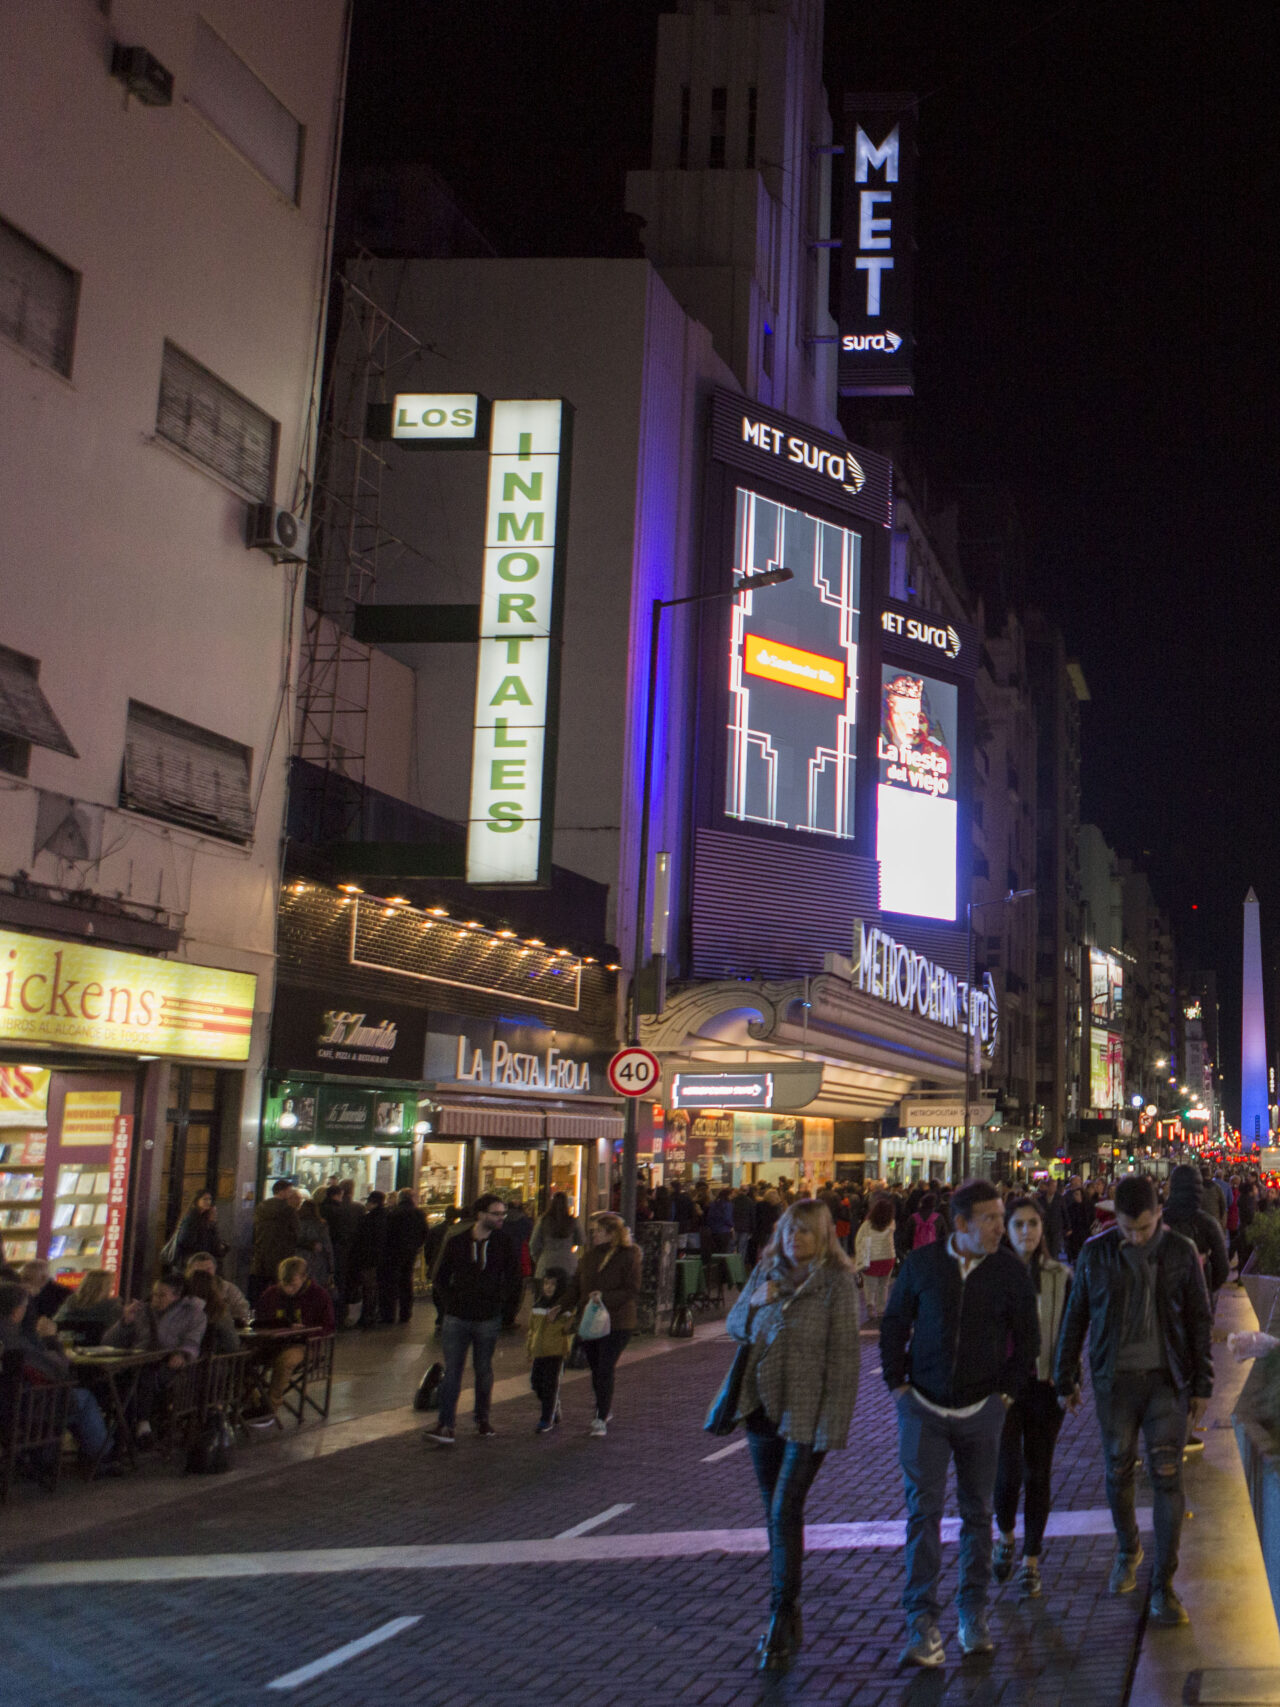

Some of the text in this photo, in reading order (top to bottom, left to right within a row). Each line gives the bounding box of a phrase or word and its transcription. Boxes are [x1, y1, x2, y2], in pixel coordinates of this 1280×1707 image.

[855, 121, 899, 316] MET
[843, 334, 885, 351] sura
[397, 408, 474, 427] LOS
[742, 416, 784, 455] MET
[486, 432, 545, 833] INMORTALES
[877, 737, 948, 774] La fiesta
[887, 764, 949, 797] del viejo
[858, 920, 957, 1027] METROPOLITAN
[456, 1035, 591, 1091] LA PASTA FROLA
[619, 1062, 649, 1082] 40
